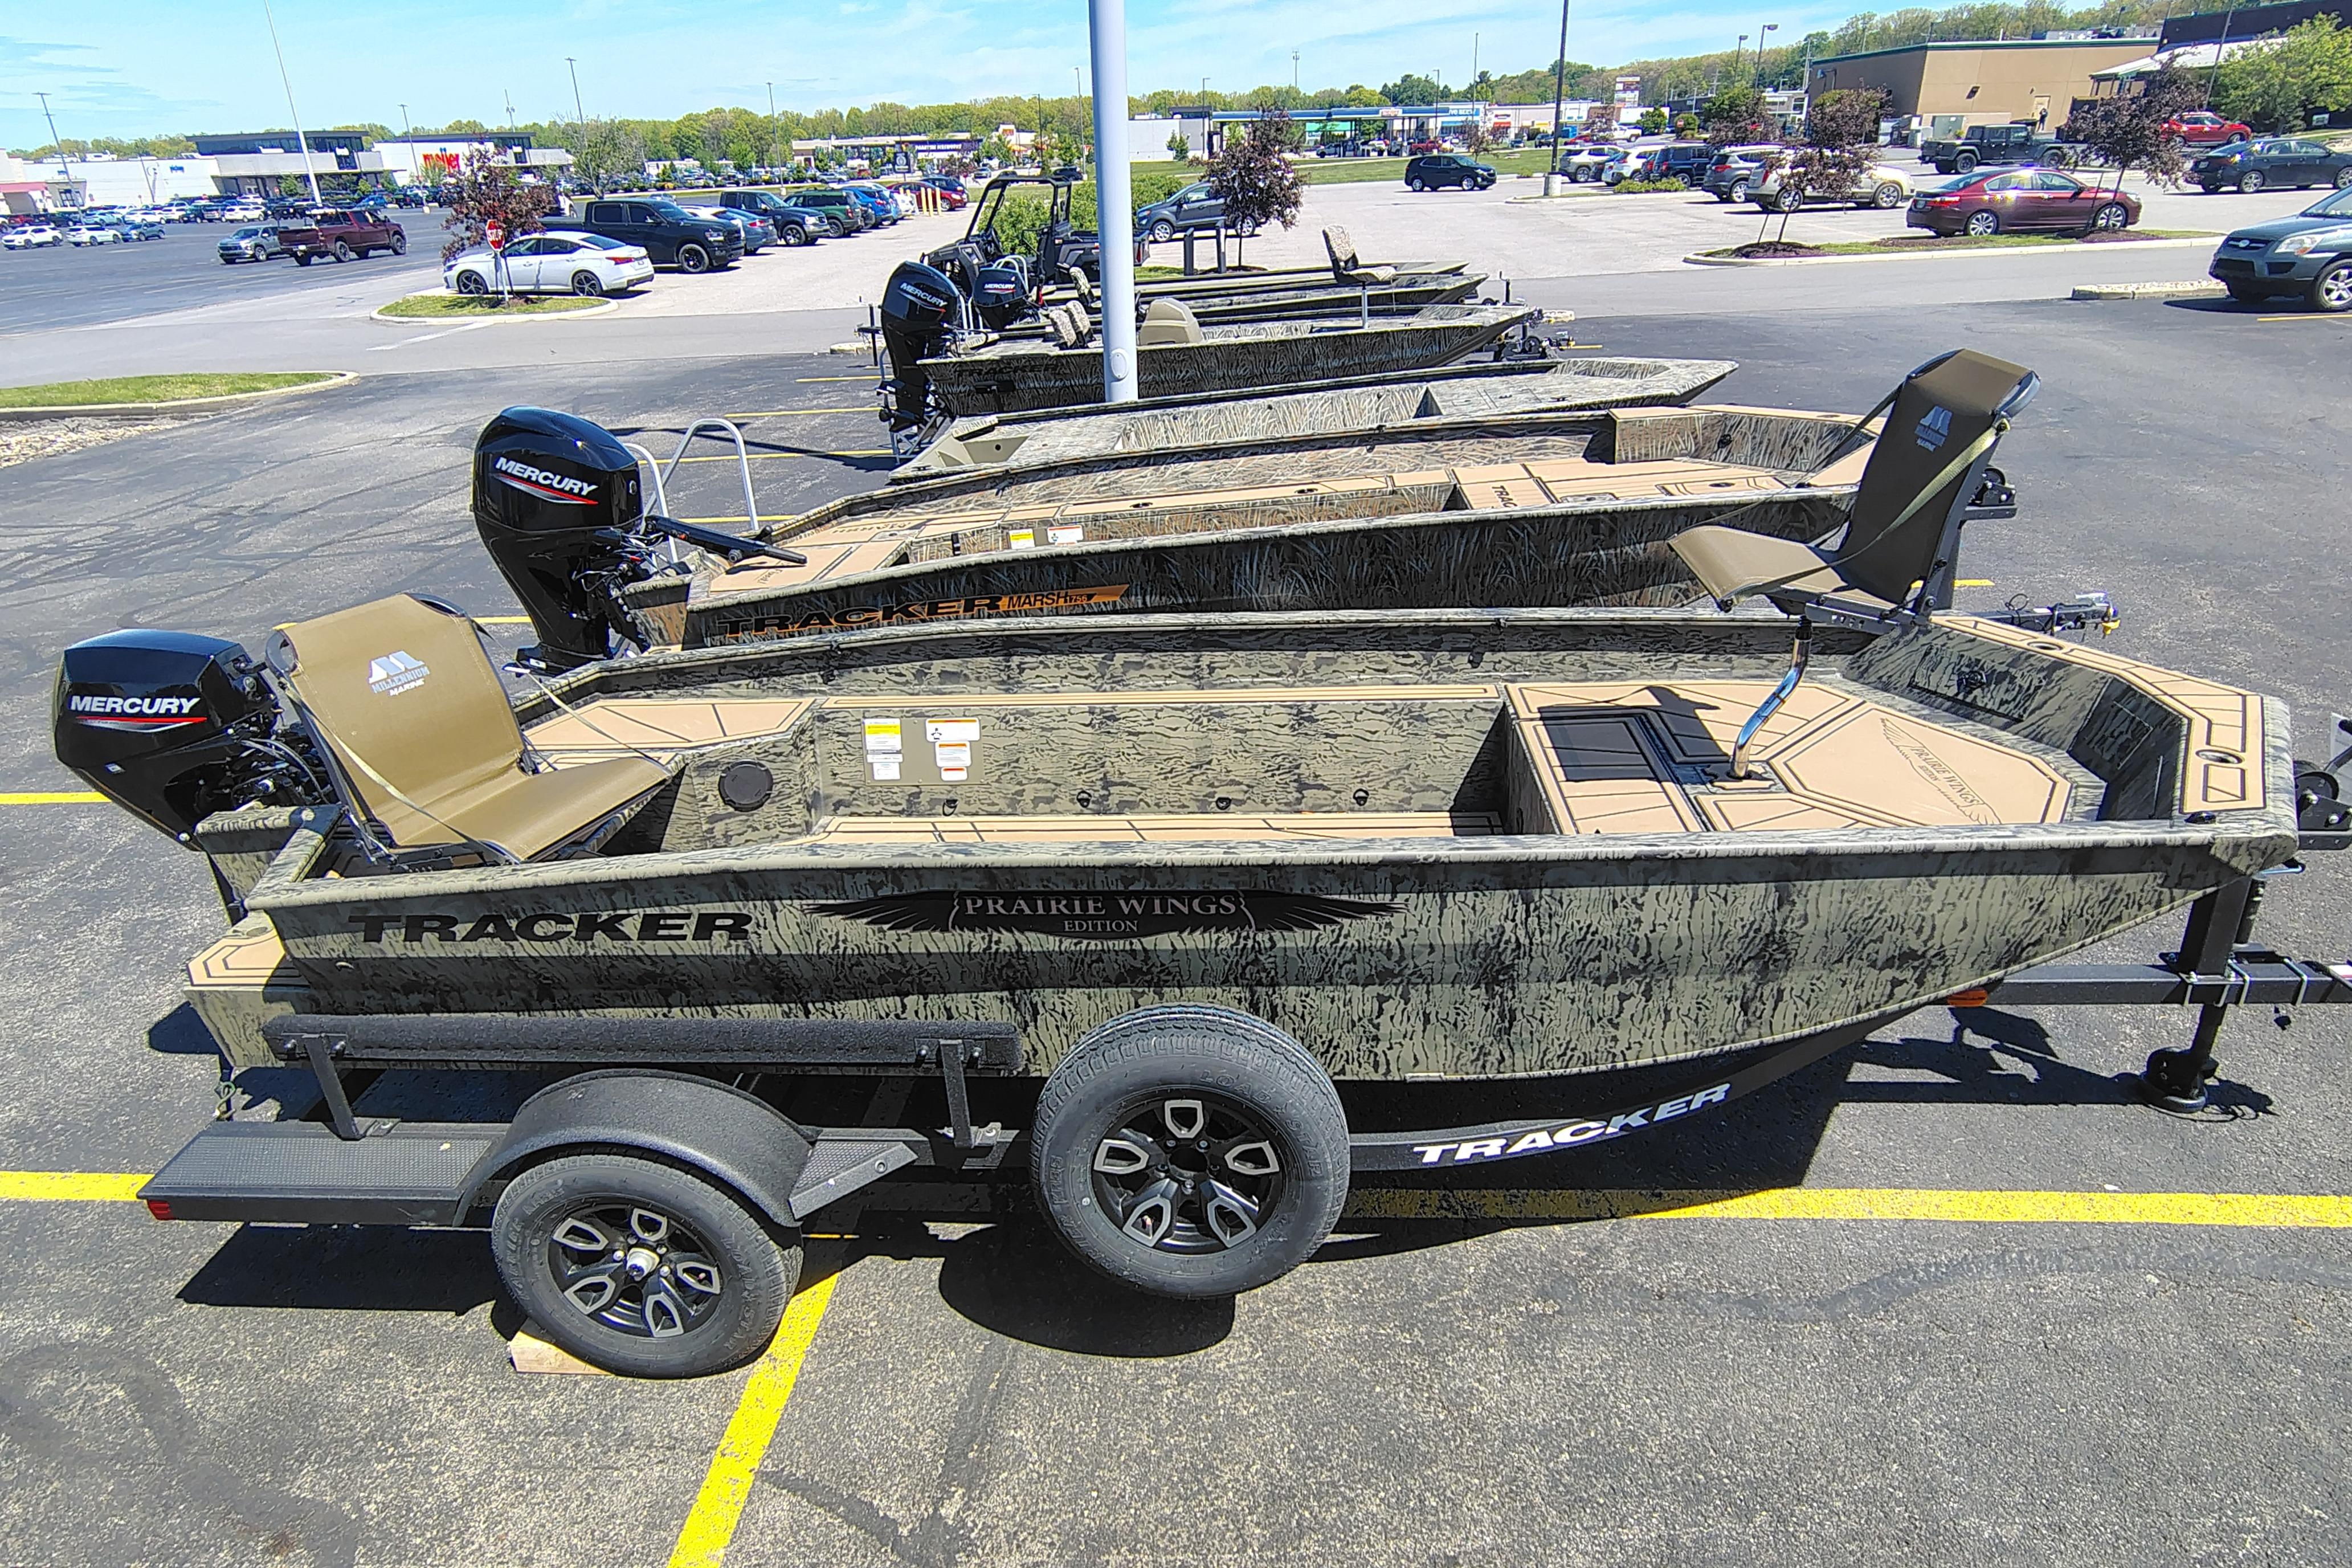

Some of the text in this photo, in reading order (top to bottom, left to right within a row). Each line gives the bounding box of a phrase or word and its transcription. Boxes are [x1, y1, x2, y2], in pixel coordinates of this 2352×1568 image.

[488, 228, 503, 241] STOP
[900, 283, 948, 307] MERCURY
[495, 457, 598, 496] MERCURY
[717, 595, 1002, 637] TRACKER
[1007, 591, 1068, 609] MARSH
[371, 665, 430, 693] MILLENNIUM
[389, 677, 425, 696] MARINE
[70, 695, 200, 713] MERCURY
[1913, 747, 1979, 804] PRAIRIE WINGS
[965, 895, 1236, 915] PRAIRIE WINGS
[348, 912, 753, 942] TRACKER
[1063, 920, 1138, 933] EDITION
[1200, 1069, 1323, 1177] LOAD STAR
[1413, 1083, 1731, 1163] TRACKER
